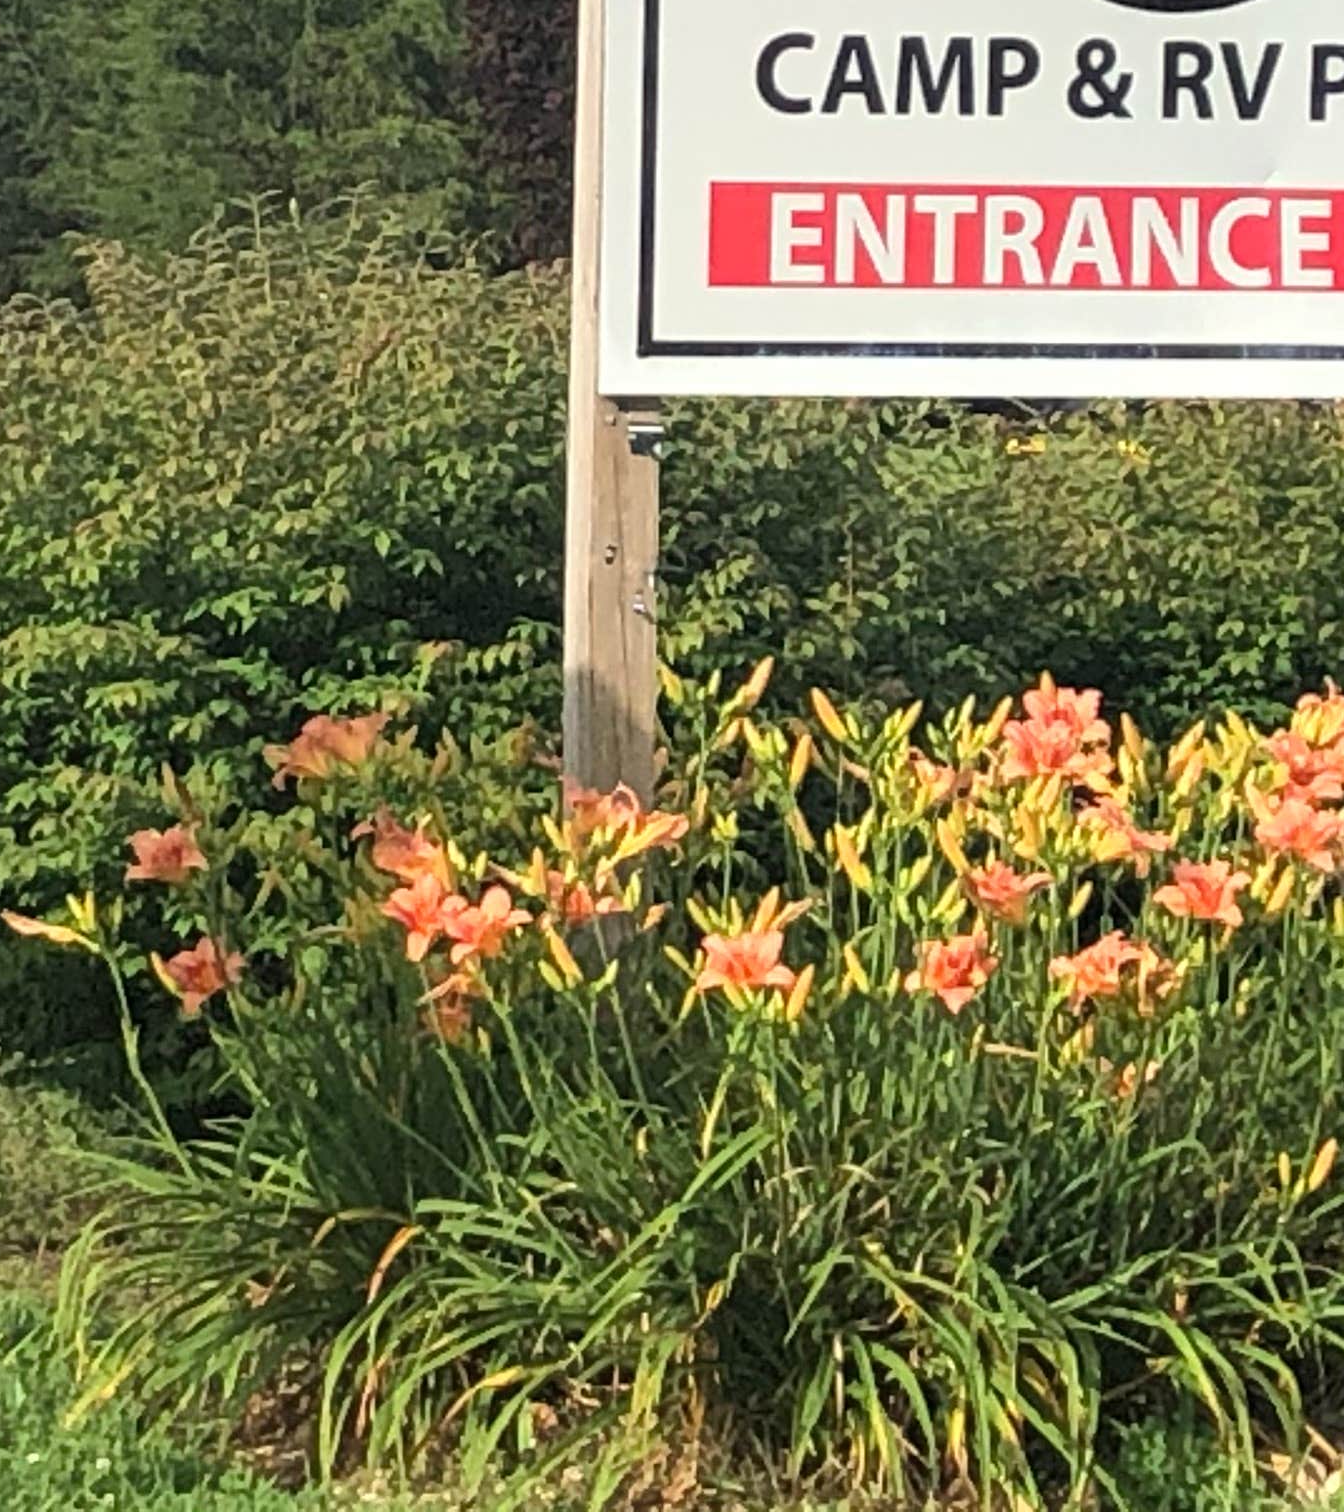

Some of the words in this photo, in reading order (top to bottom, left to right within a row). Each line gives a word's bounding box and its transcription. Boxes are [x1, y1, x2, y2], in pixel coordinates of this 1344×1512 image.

[756, 32, 1041, 118] CAMP
[1068, 38, 1133, 119] &
[1161, 42, 1283, 122] RV
[769, 193, 1336, 288] ENTRANCE
